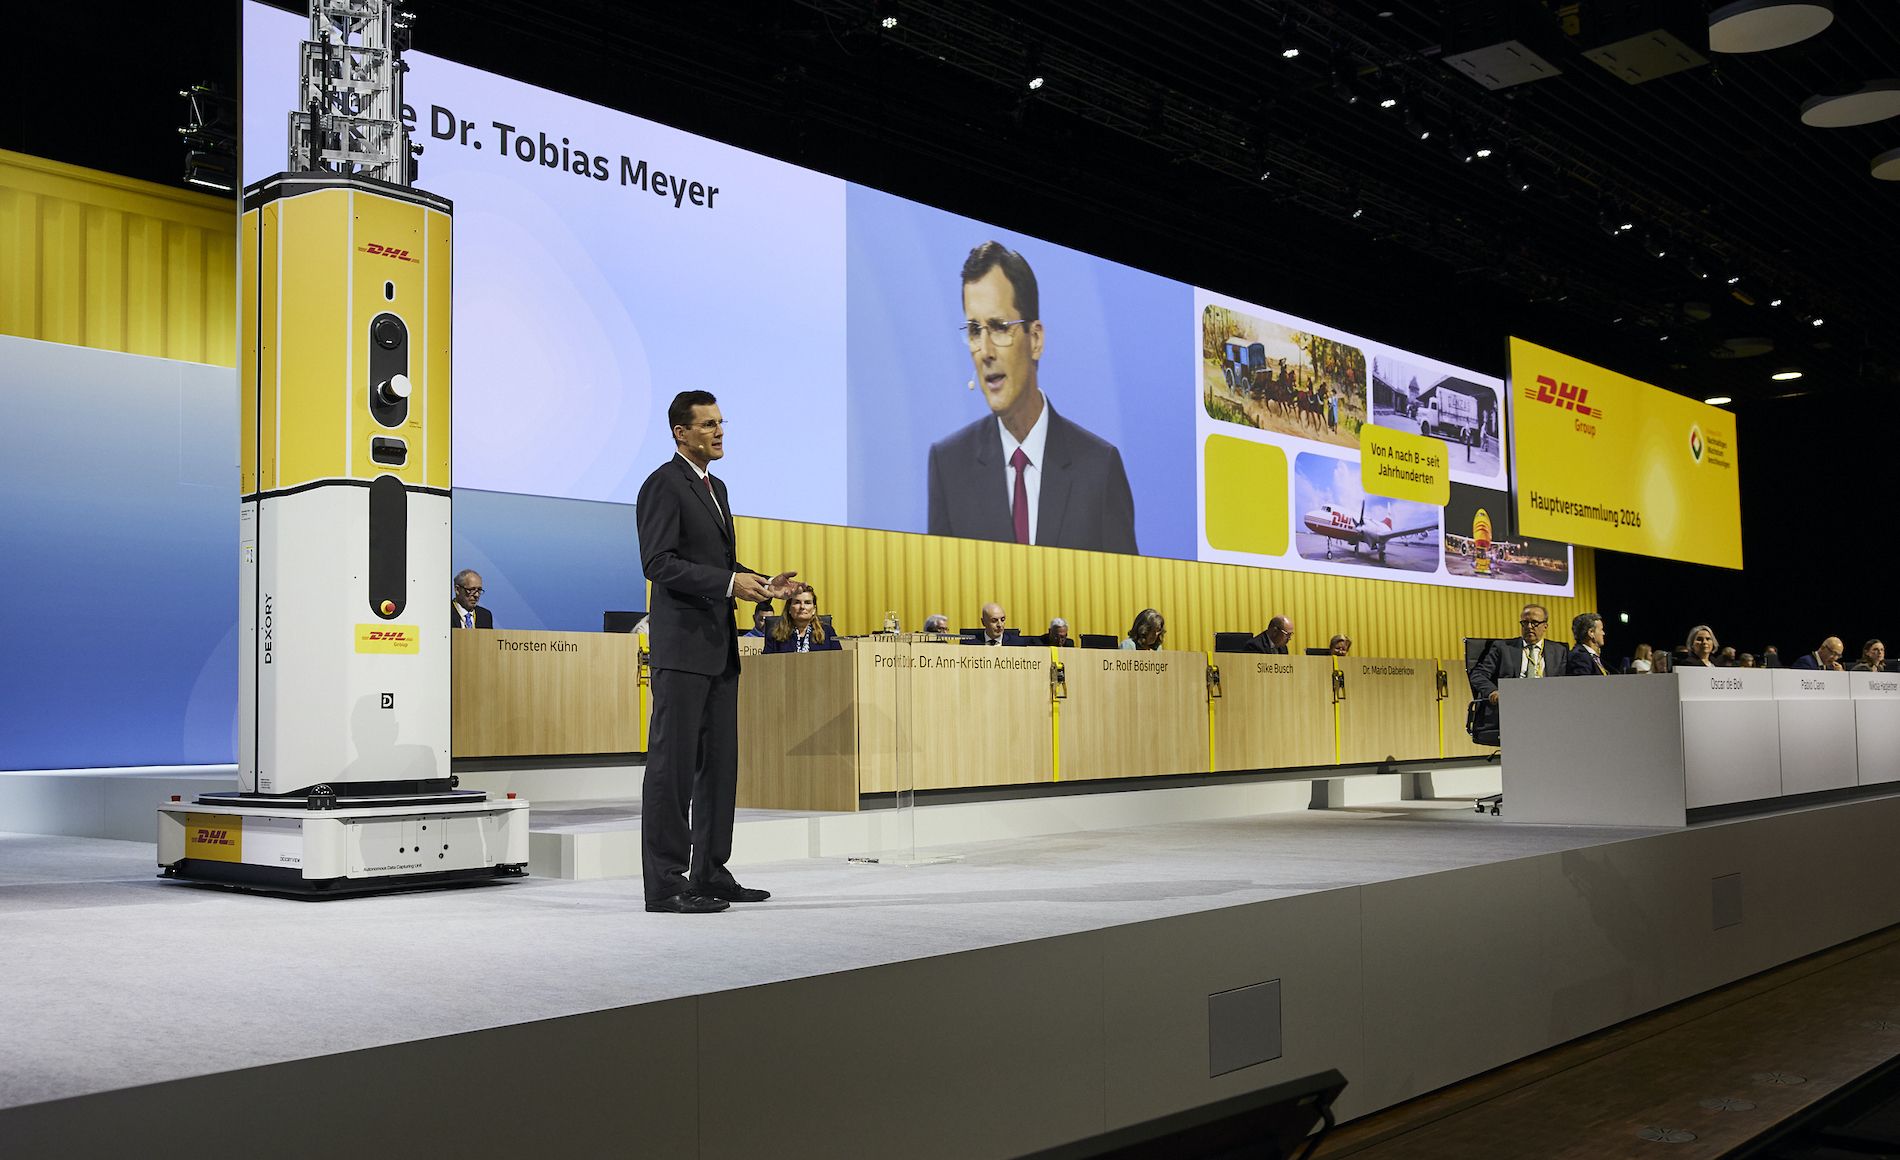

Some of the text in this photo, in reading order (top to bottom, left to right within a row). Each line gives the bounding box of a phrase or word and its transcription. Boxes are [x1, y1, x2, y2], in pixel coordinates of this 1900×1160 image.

[431, 104, 482, 150] Dr.
[492, 121, 609, 181] Tobias
[620, 155, 719, 209] Meyer
[367, 243, 411, 261] DHL
[1536, 374, 1592, 415] DHL
[1575, 418, 1596, 438] Group
[1371, 442, 1386, 457] Von
[1388, 446, 1393, 458] A
[1395, 450, 1413, 463] nach
[1414, 452, 1420, 464] B
[1426, 455, 1440, 468] seit
[1378, 463, 1434, 485] Jahrhunderten
[1530, 490, 1641, 528] Hauptversammlung 2026
[1332, 511, 1353, 529] DHL
[264, 592, 272, 664] DEXORY
[369, 631, 406, 640] DHL
[497, 639, 578, 652] Thorsten Kühn
[919, 655, 933, 668] Dr.
[935, 656, 992, 669] Ann-Kristin
[994, 657, 1041, 670] Achleitner
[1103, 659, 1168, 675] Dr. Rolf Bösinger
[1257, 662, 1294, 674] Silke Busch
[1372, 665, 1387, 675] Mario
[1710, 677, 1743, 690] Oscar de Bok
[197, 829, 228, 845] DHL
